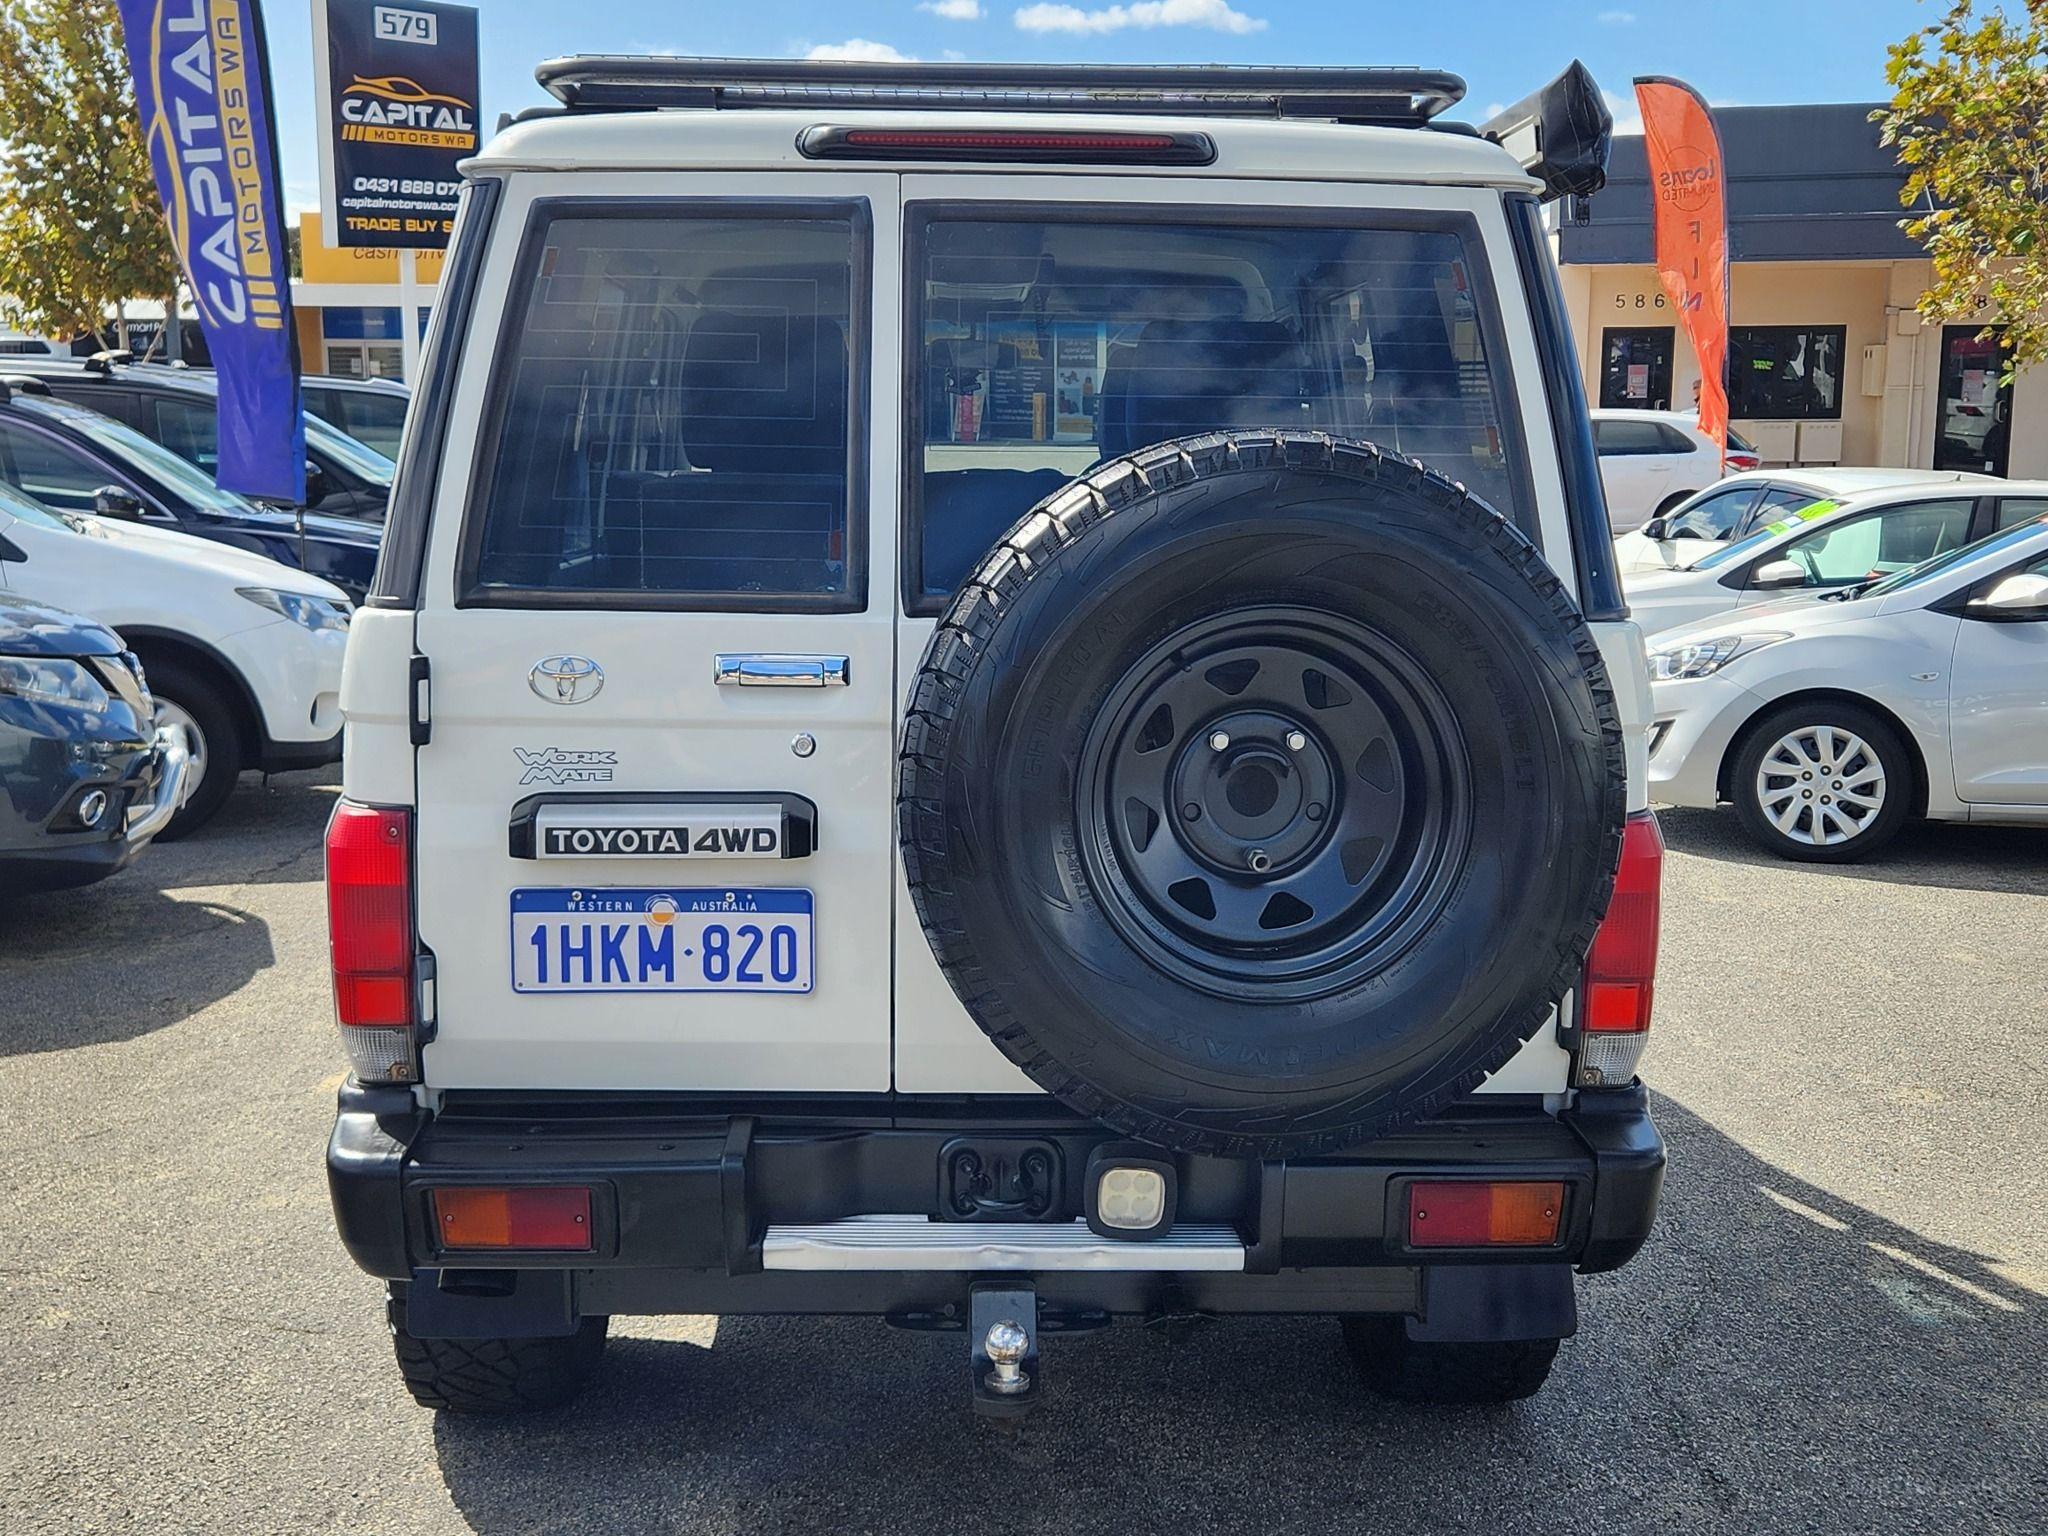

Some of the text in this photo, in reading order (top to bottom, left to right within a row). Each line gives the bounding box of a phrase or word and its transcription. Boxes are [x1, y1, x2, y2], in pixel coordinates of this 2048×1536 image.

[382, 13, 431, 39] 579
[342, 99, 472, 130] CAPITAL
[217, 17, 265, 255] MOTORS WA
[374, 130, 466, 146] MOTORS WA
[168, 0, 247, 324] CAPITAL
[354, 177, 398, 193] 0431
[400, 180, 434, 194] 888
[346, 217, 400, 231] TRADE
[406, 219, 437, 232] BUY
[1615, 293, 1666, 309] 586
[112, 321, 152, 332] Crmart
[513, 747, 618, 765] WORK
[519, 766, 612, 785] MATE
[552, 828, 778, 853] TOYOTA 4WD
[567, 900, 758, 912] WESTERN AUSTRALIA
